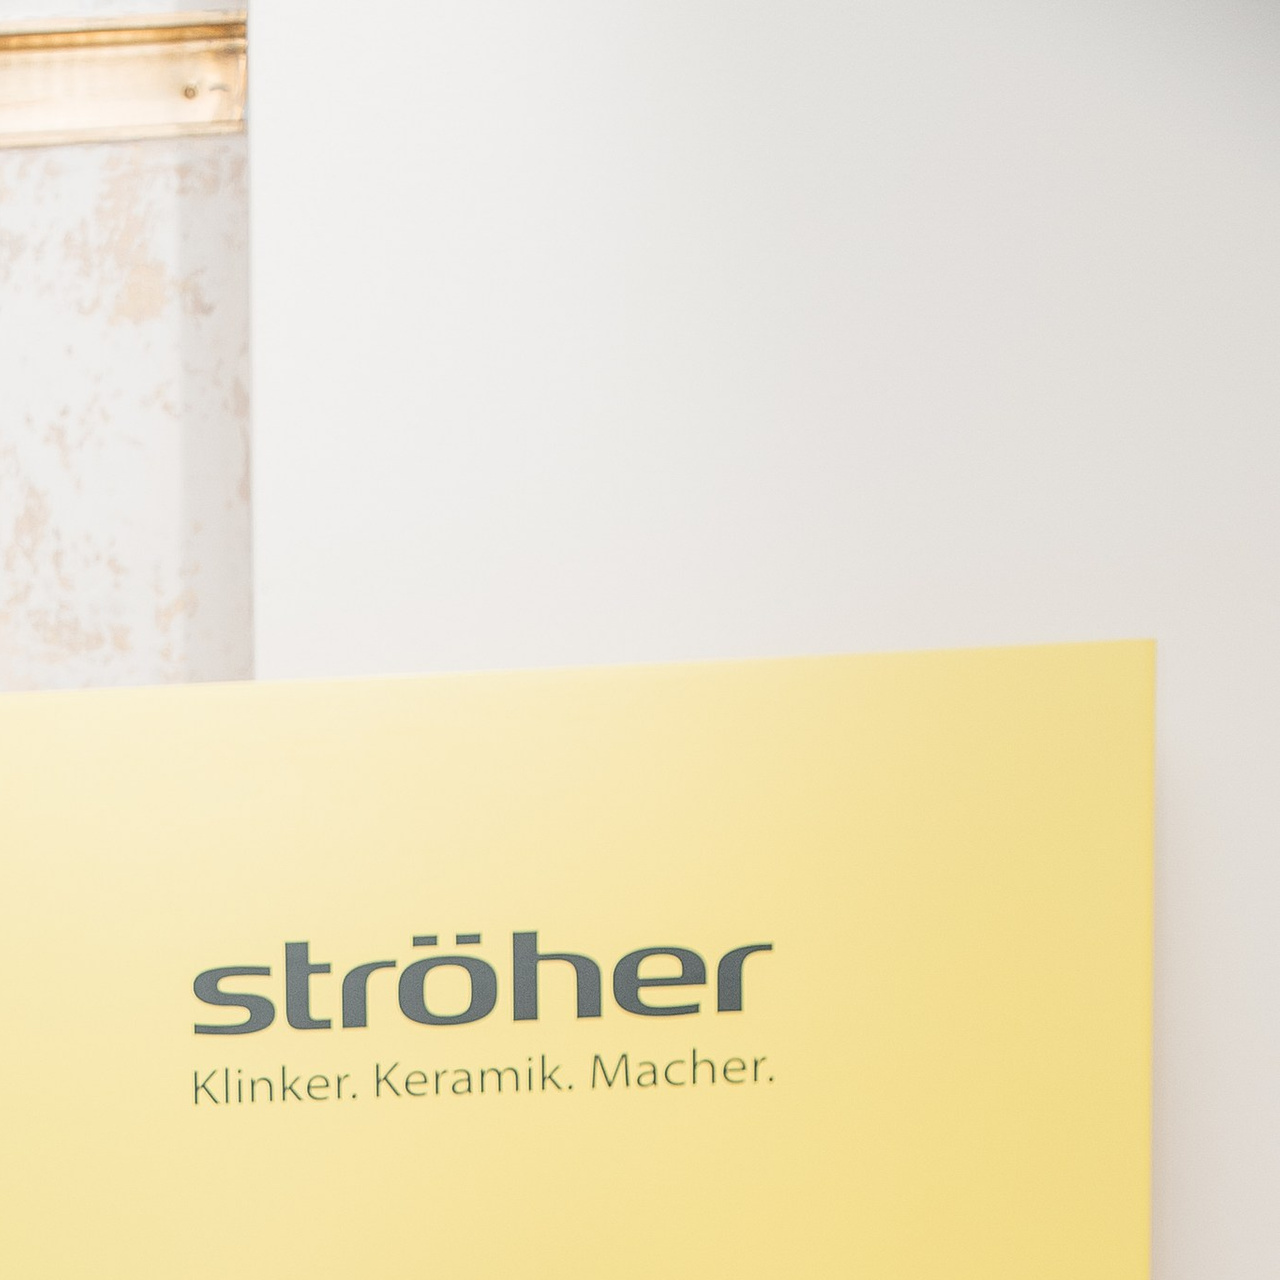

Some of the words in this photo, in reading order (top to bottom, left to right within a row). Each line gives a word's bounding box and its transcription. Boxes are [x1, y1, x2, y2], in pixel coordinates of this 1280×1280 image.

[193, 931, 773, 1035] ströher
[194, 1065, 357, 1105] Klinker.
[375, 1055, 573, 1098] Keramik.
[592, 1048, 774, 1088] Macher.
